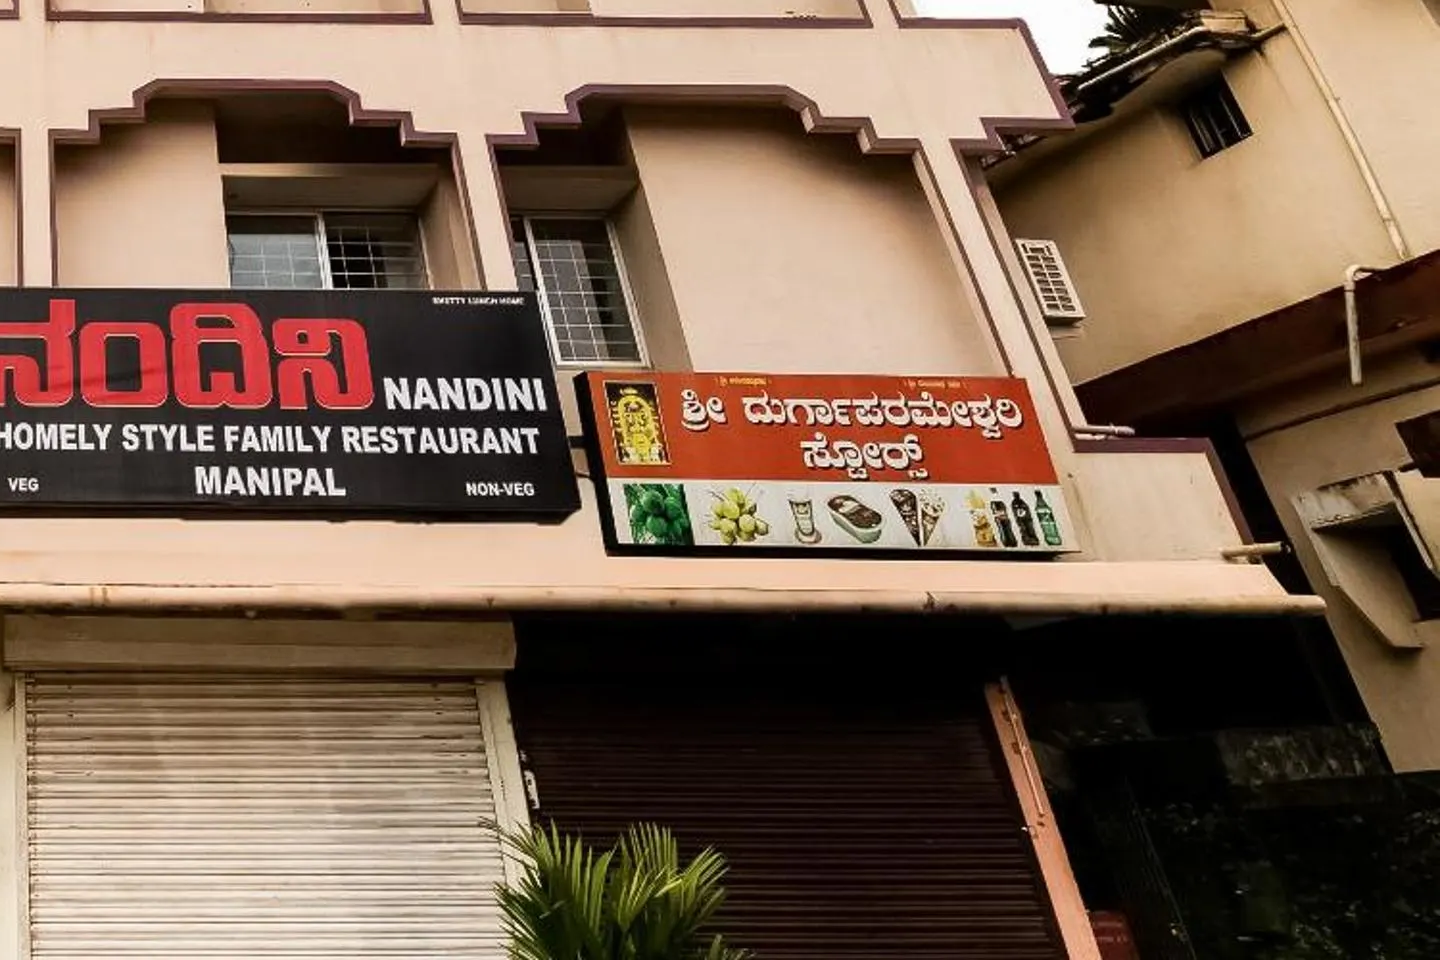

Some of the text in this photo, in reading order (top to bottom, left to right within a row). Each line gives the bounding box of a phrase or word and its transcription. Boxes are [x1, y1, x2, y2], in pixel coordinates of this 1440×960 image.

[383, 376, 548, 412] NANDINI
[680, 389, 1024, 439] ಶ್ರೀ ದುರ್ಗಾಪರಮೇಶ್ವರಿ
[122, 425, 216, 452] STYLE
[223, 425, 333, 454] FAMILY
[342, 426, 540, 455] RESTAURANT
[799, 431, 930, 480] ಸ್ಟೋರ್ಸ್
[7, 477, 40, 492] VEG
[195, 465, 347, 498] MANIPAL
[466, 481, 536, 497] NON-VEG
